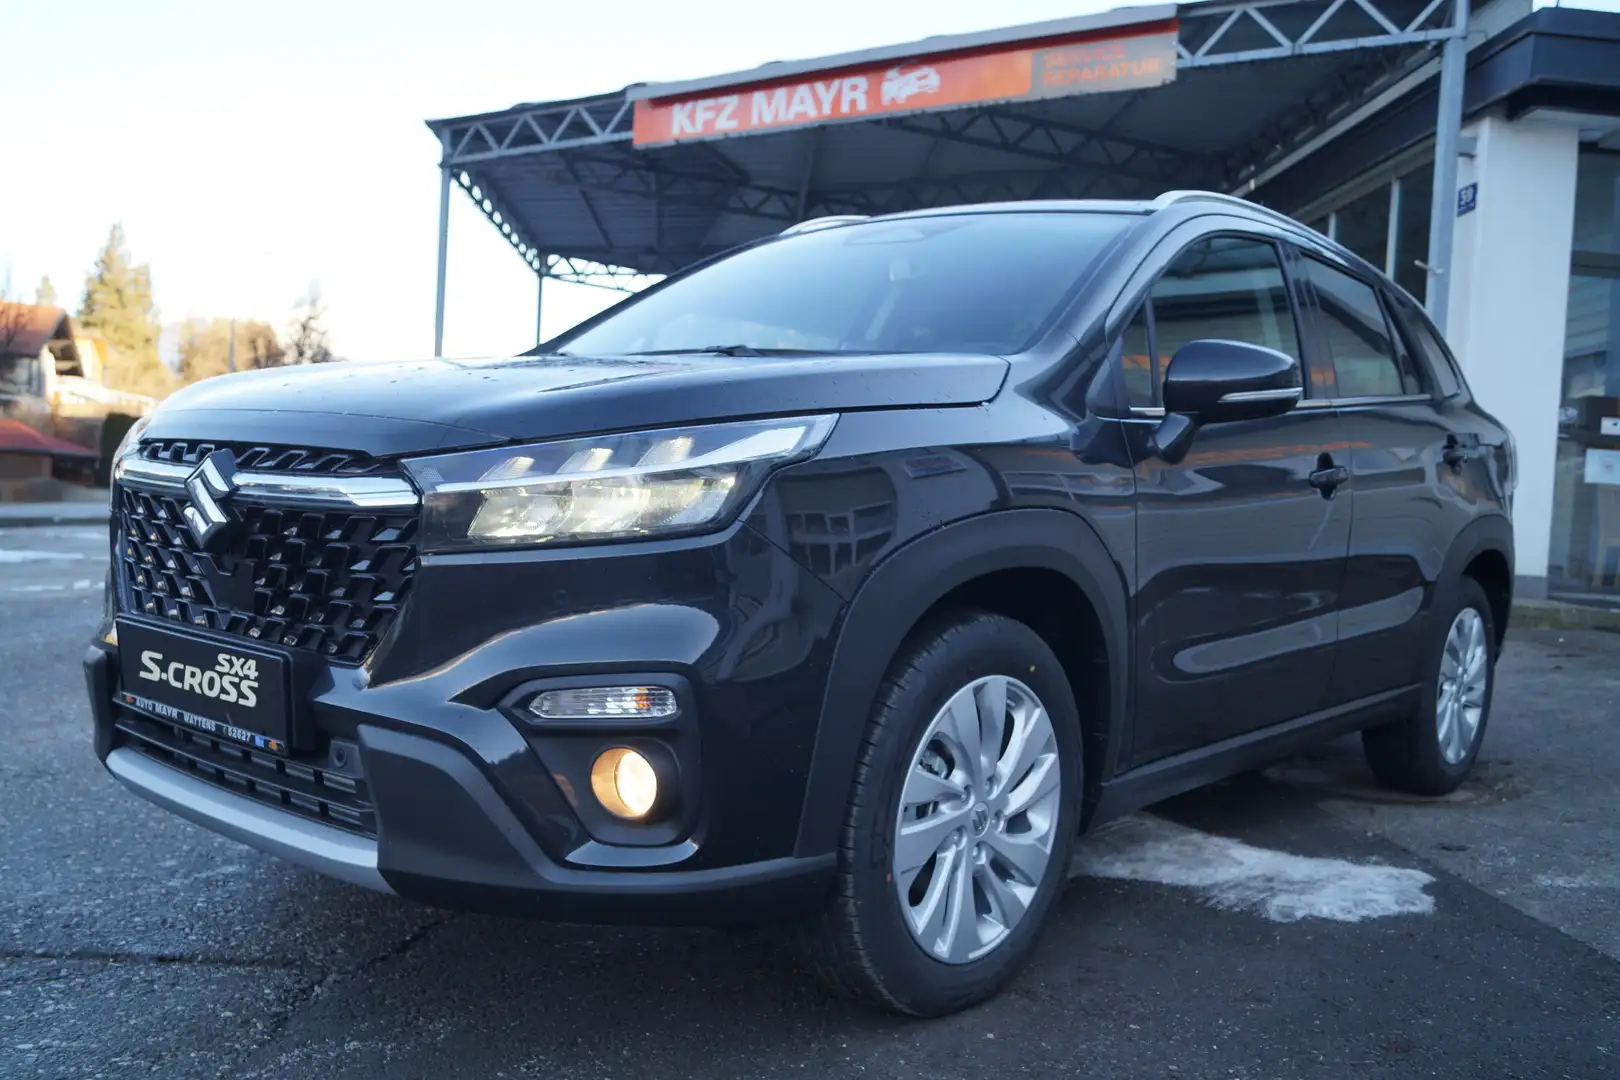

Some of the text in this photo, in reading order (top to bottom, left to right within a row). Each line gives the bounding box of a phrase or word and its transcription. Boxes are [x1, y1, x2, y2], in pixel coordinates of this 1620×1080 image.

[671, 76, 868, 135] KFZ MAYR
[214, 653, 259, 680] SX4
[135, 698, 153, 711] AUTO
[155, 703, 178, 718] MAYR
[183, 711, 217, 732] WATTENS
